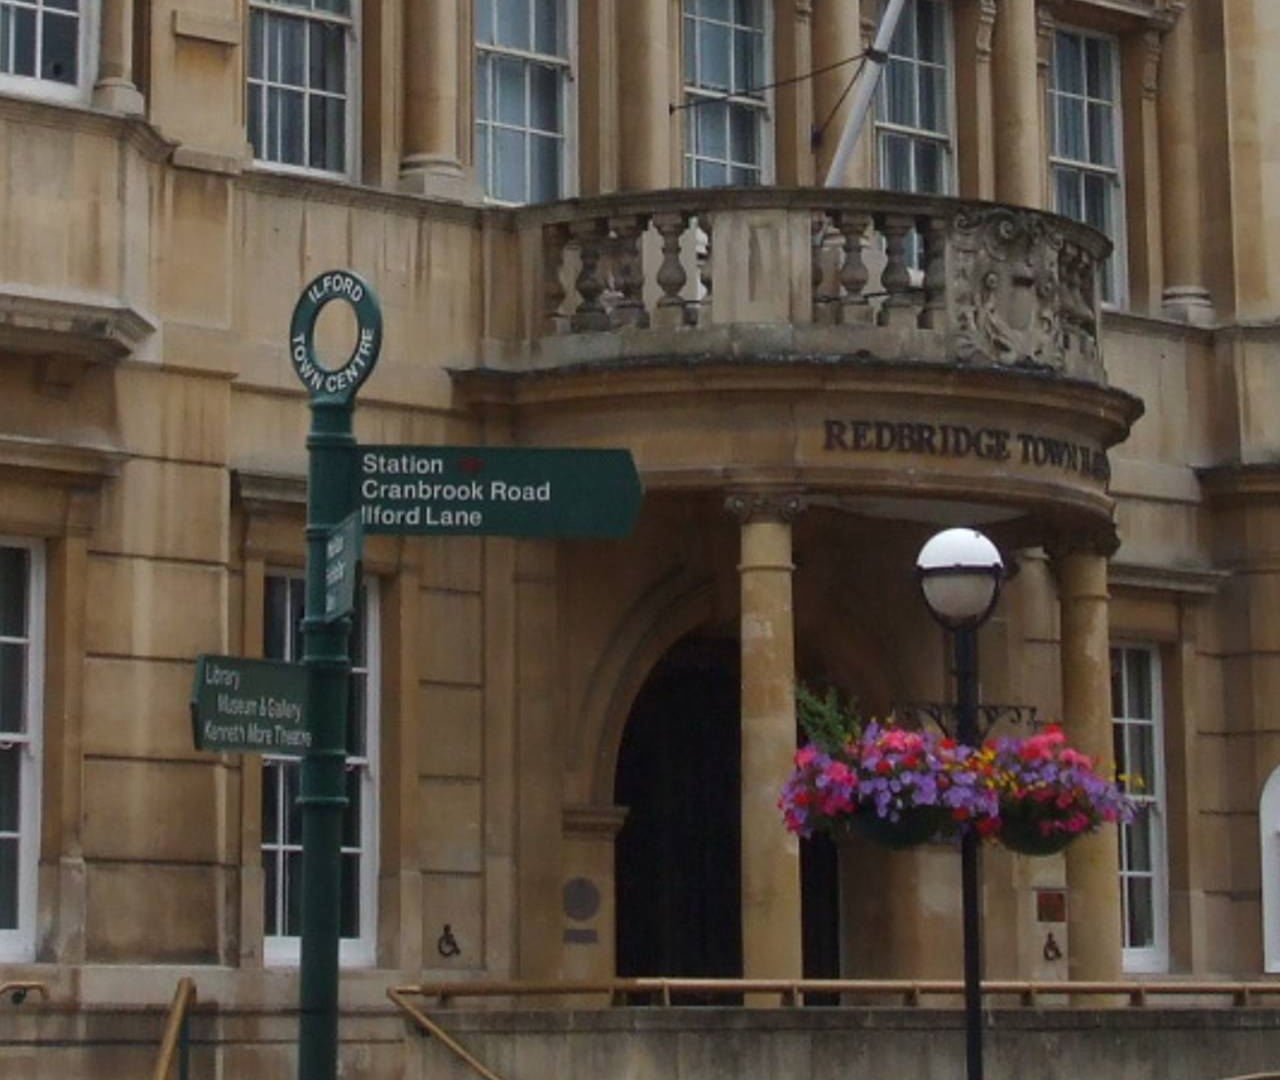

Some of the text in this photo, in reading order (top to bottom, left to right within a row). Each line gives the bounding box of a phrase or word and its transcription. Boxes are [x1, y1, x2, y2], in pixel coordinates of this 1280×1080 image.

[308, 274, 363, 304] ILFORD
[293, 328, 375, 392] TOWN CENTRE
[823, 420, 1011, 462] REDBRIDGE
[1017, 433, 1078, 473] TOWN
[363, 453, 443, 473] Station
[361, 479, 551, 501] Cranbrook Road
[361, 505, 482, 526] Ilford Lane
[205, 663, 240, 690] Library
[217, 693, 301, 722] Museum & Gallery
[204, 720, 313, 748] Kenneth More Theatre
